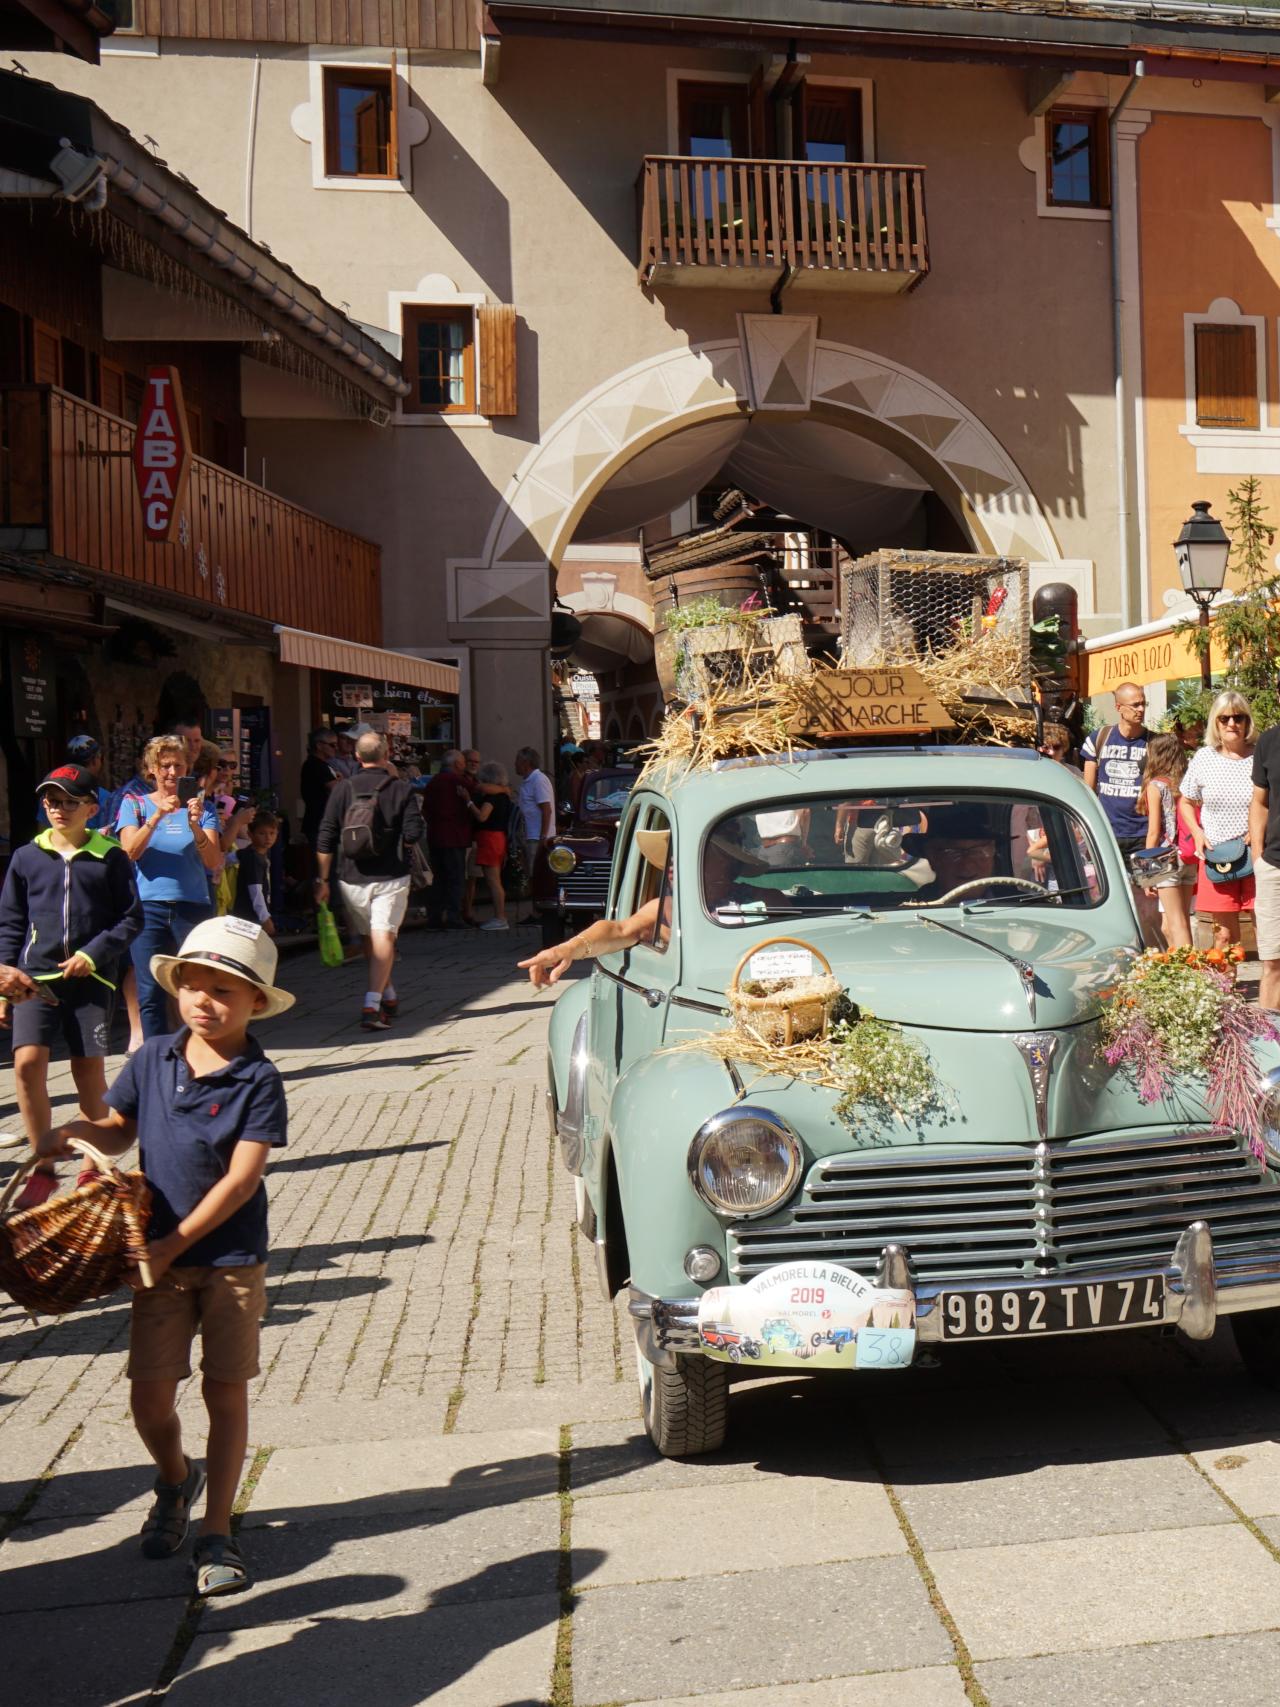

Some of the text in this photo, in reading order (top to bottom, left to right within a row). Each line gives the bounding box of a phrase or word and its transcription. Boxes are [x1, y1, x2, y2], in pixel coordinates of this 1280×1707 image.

[142, 378, 177, 531] TABAC
[1102, 643, 1172, 686] JIMBO LOLO
[384, 680, 411, 700] bien
[836, 676, 905, 698] JOUR
[798, 697, 929, 729] de MARCHÉ
[754, 1267, 868, 1299] VALMOREL LA BIELLE
[790, 1287, 825, 1304] 2019
[778, 1309, 818, 1318] VALMOREL
[948, 1278, 1160, 1336] 9892 TV 74
[861, 1333, 902, 1365] 38
